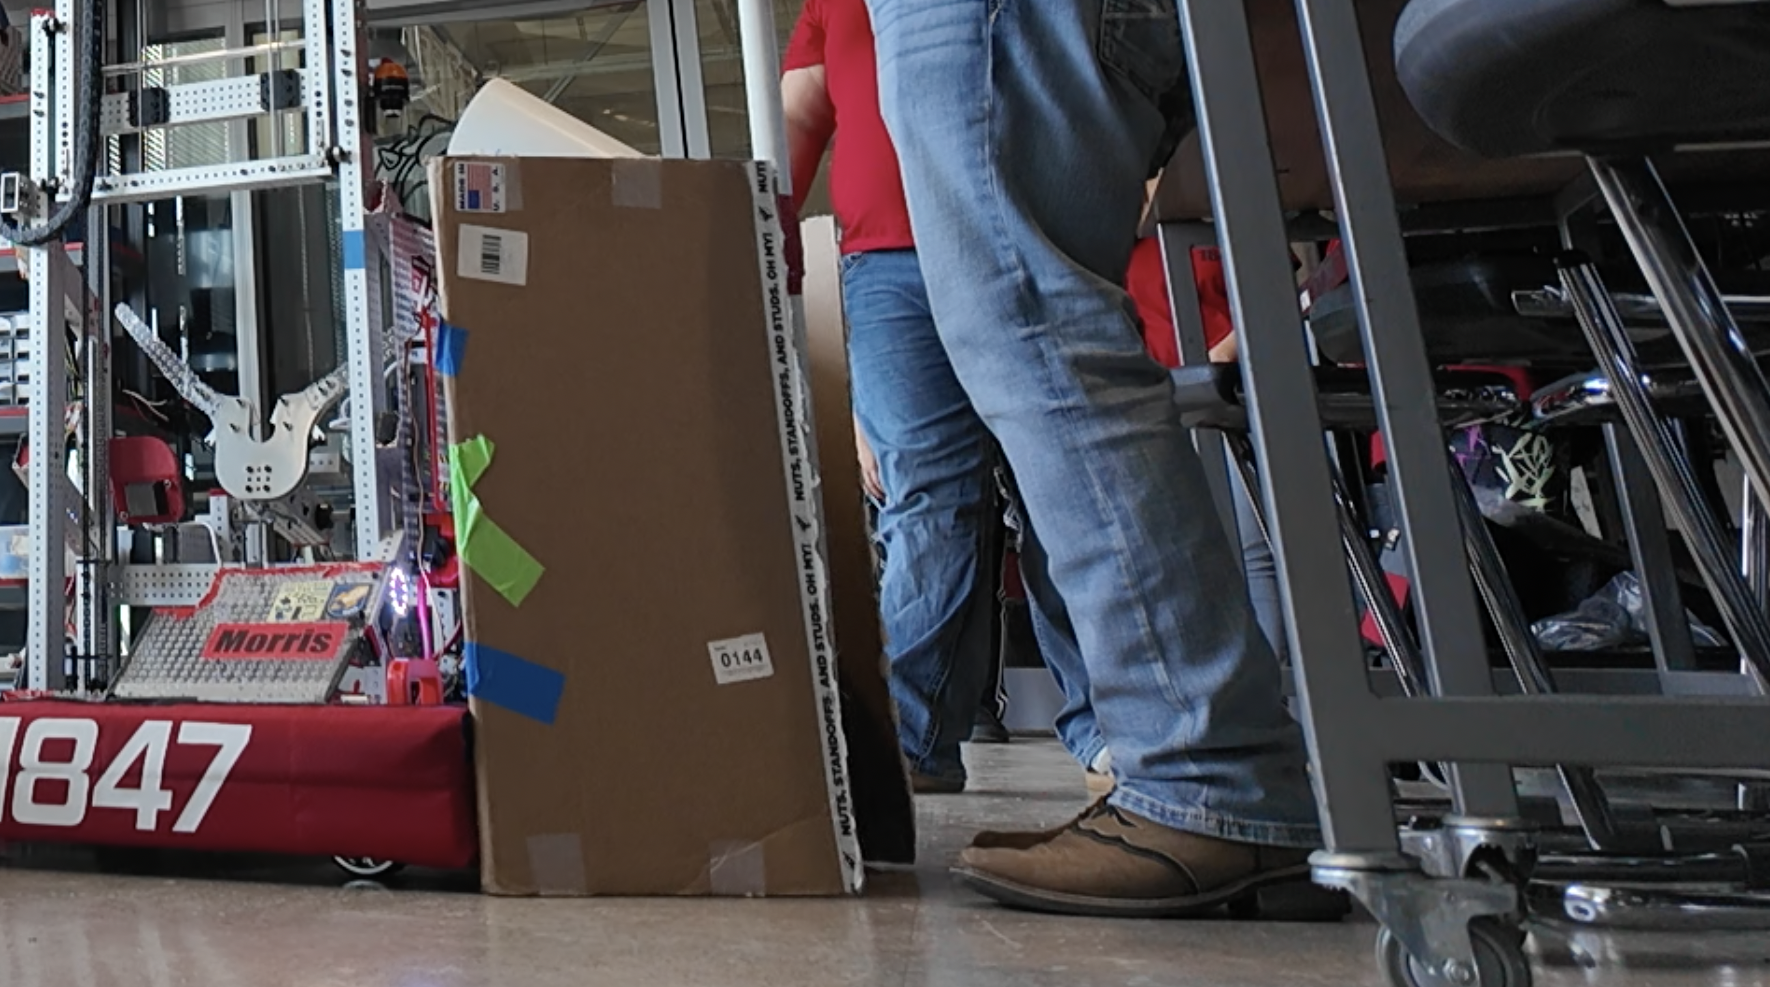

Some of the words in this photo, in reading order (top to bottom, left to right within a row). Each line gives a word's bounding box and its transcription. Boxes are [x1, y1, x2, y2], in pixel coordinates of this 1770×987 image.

[755, 161, 768, 193] NUT
[762, 233, 775, 257] MY!
[767, 260, 778, 280] OH
[774, 335, 788, 364] AND
[779, 368, 798, 456] STANDOFFS,
[790, 459, 805, 501] NUTS,
[806, 574, 818, 595] OH
[213, 629, 333, 654] Morris
[721, 648, 763, 668] 0144
[816, 657, 830, 687] AND
[836, 790, 852, 836] NUTS,
